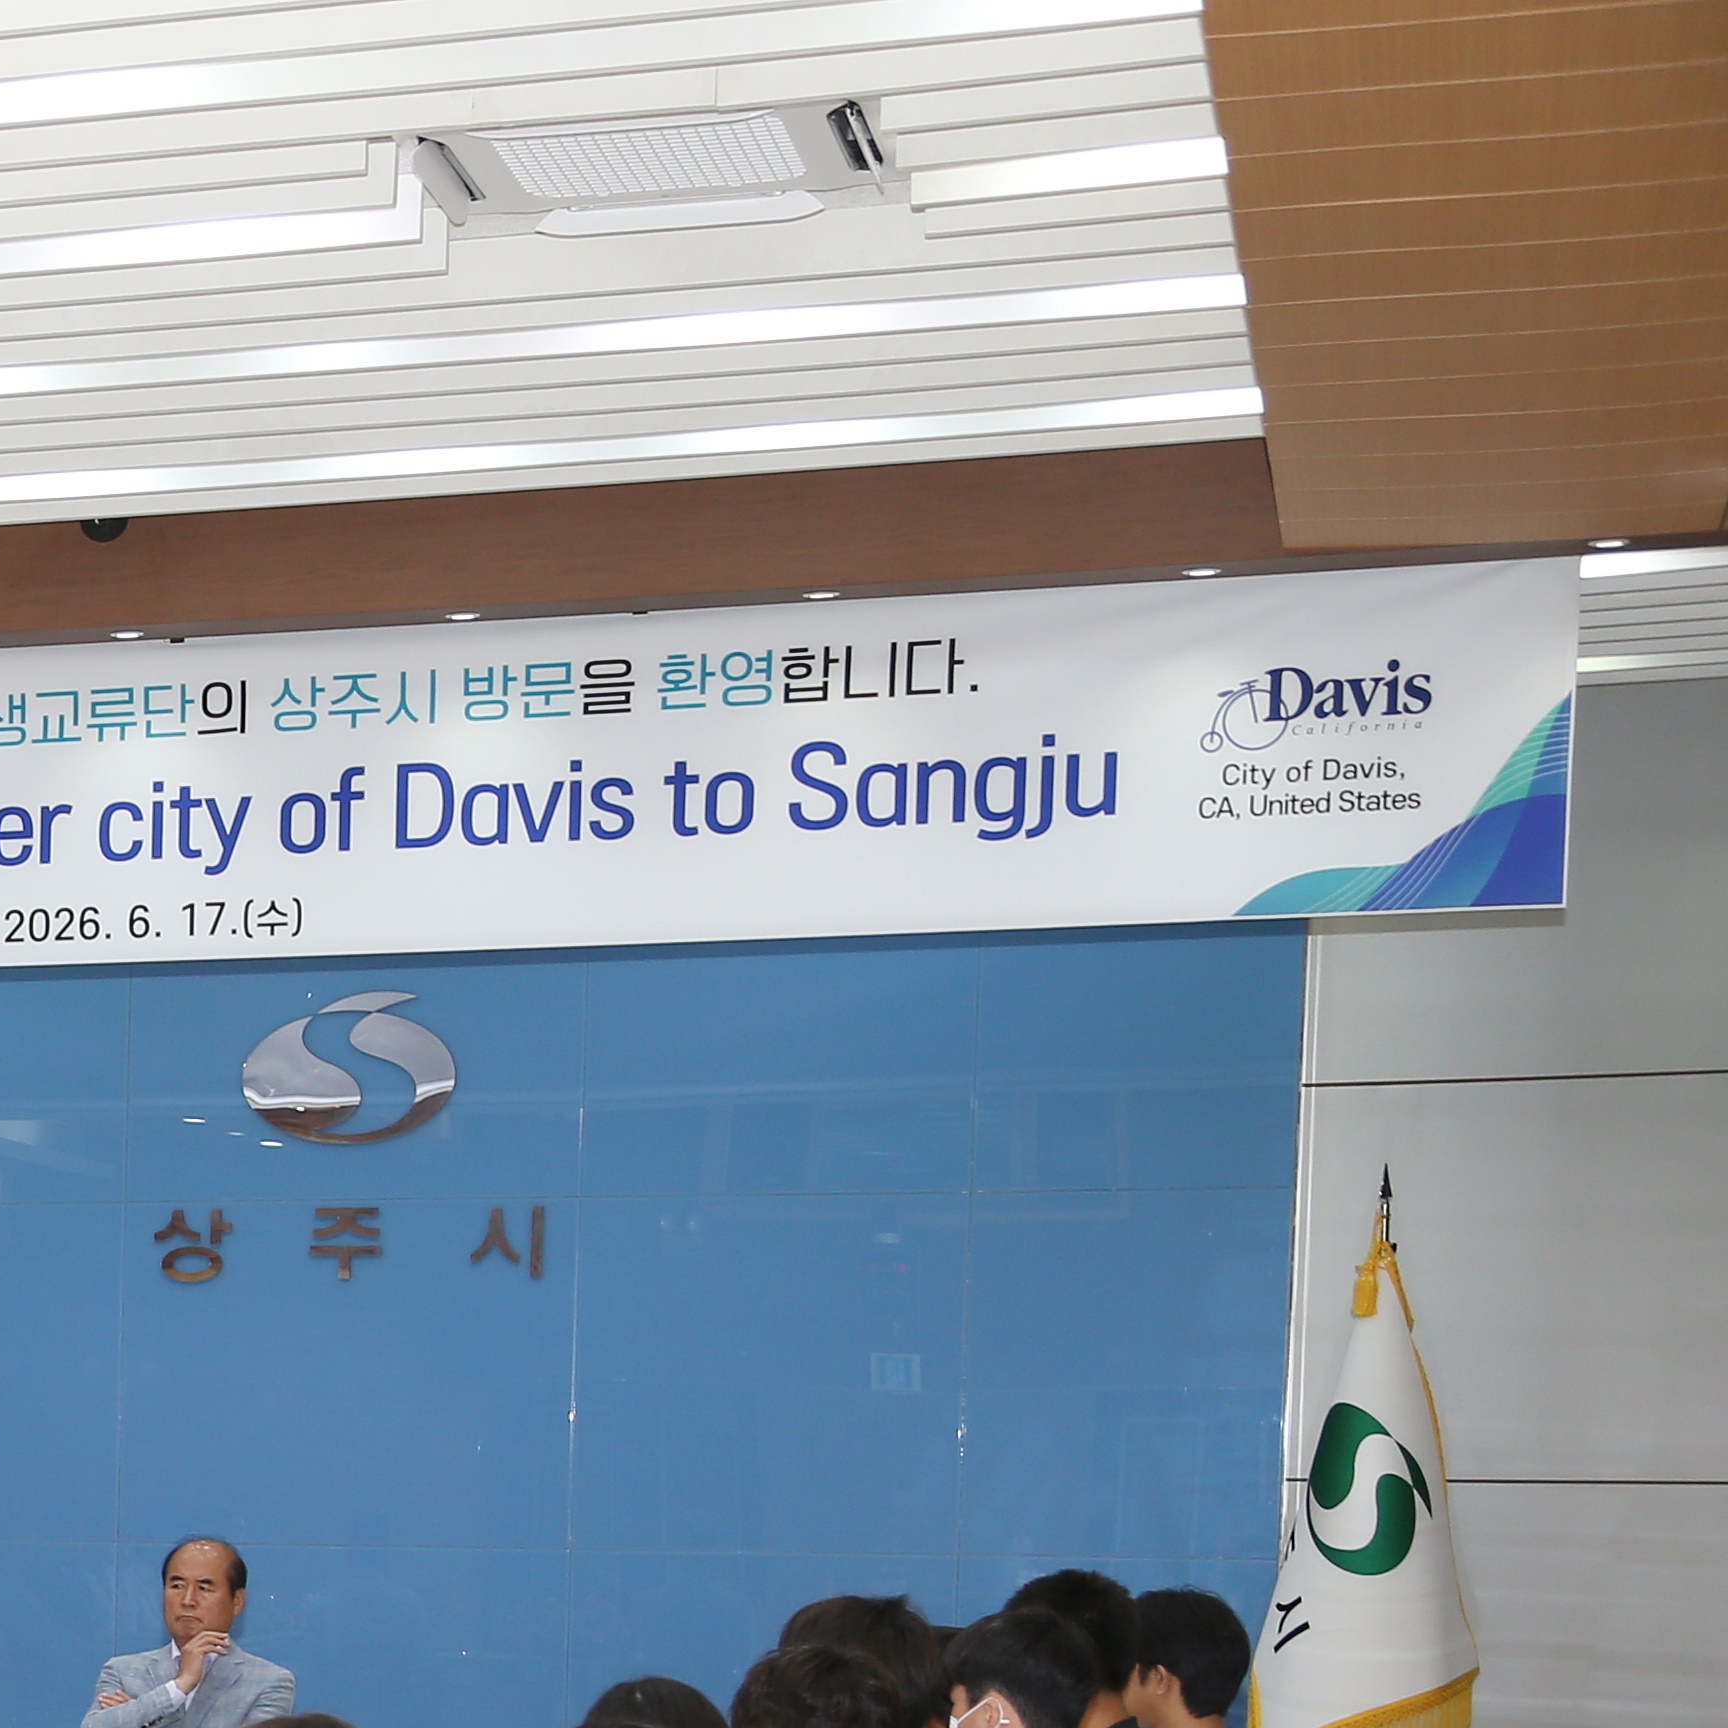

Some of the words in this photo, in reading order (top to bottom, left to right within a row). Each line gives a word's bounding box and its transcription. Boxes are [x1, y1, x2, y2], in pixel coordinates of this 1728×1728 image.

[270, 668, 438, 733] 상주시
[462, 656, 635, 722] 방문을
[656, 637, 979, 711] 환영합니다.
[1262, 658, 1433, 723] Davis
[1290, 720, 1423, 736] California
[1221, 762, 1276, 791] City
[1285, 759, 1314, 783] of
[1322, 755, 1406, 782] Davis,
[97, 780, 253, 876] city
[279, 765, 366, 854] of
[394, 758, 636, 851] Davis
[663, 760, 757, 838] to
[787, 733, 1119, 842] Sangju
[1198, 795, 1241, 820] CA,
[1249, 791, 1332, 817] United
[1338, 789, 1422, 813] States
[3, 906, 113, 944] 2026.
[127, 904, 163, 939] 6.
[180, 896, 303, 939] 17.(수)
[153, 1205, 545, 1283] 상주시
